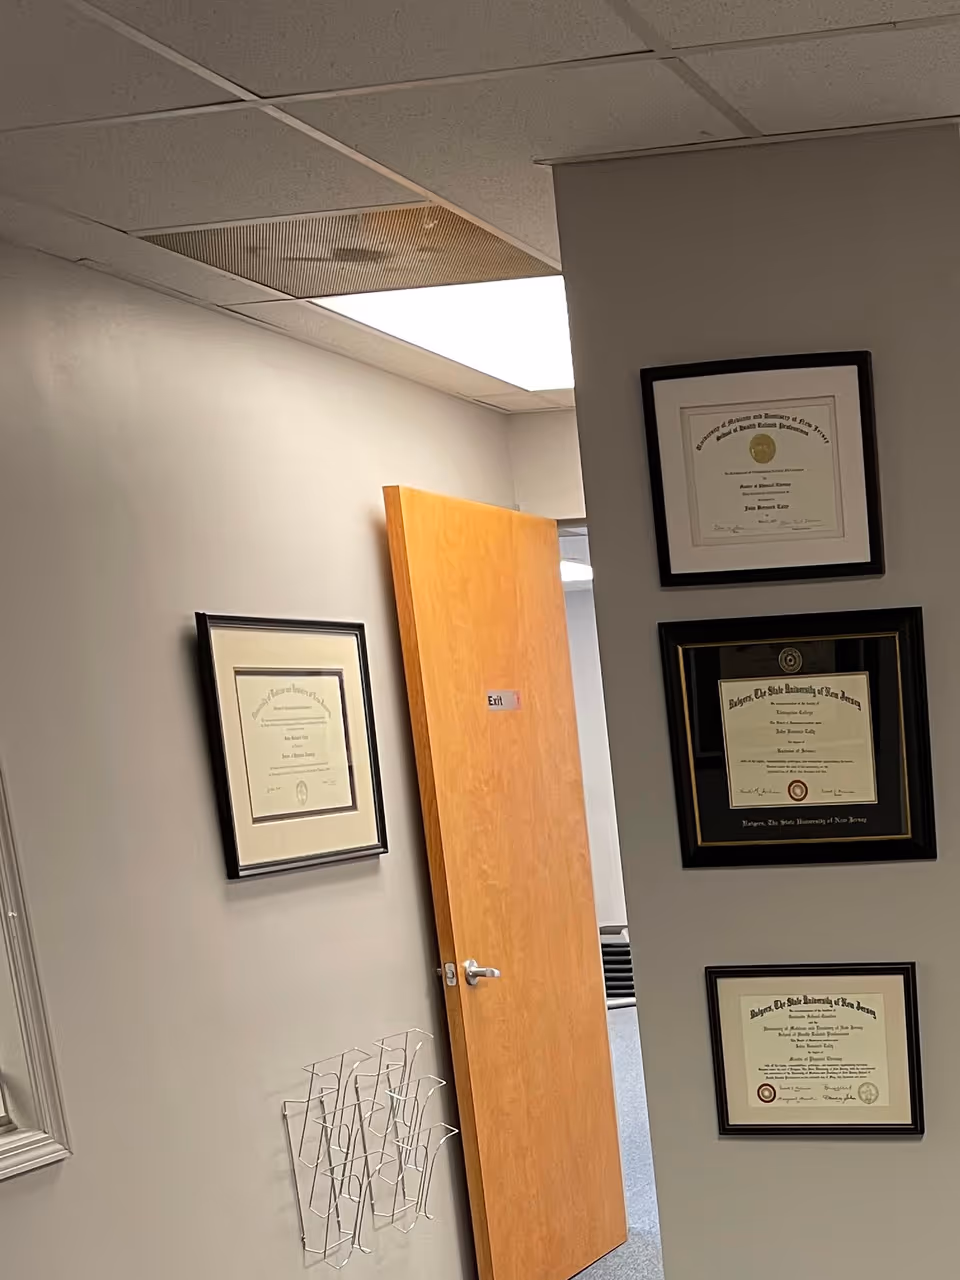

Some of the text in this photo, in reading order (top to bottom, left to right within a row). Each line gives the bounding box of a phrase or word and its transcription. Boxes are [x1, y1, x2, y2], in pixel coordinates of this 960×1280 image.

[488, 695, 503, 706] Exit
[754, 688, 766, 699] The
[768, 684, 784, 696] State
[785, 683, 816, 698] University
[817, 687, 824, 695] of
[824, 686, 839, 700] New
[840, 690, 861, 711] Jersey
[780, 818, 795, 826] State
[796, 818, 826, 826] University
[848, 816, 867, 824] Jersey
[774, 999, 786, 1010] The
[787, 997, 802, 1007] State
[803, 995, 833, 1008] University
[834, 997, 841, 1005] of
[841, 997, 854, 1009] New
[856, 1000, 877, 1020] Jersey
